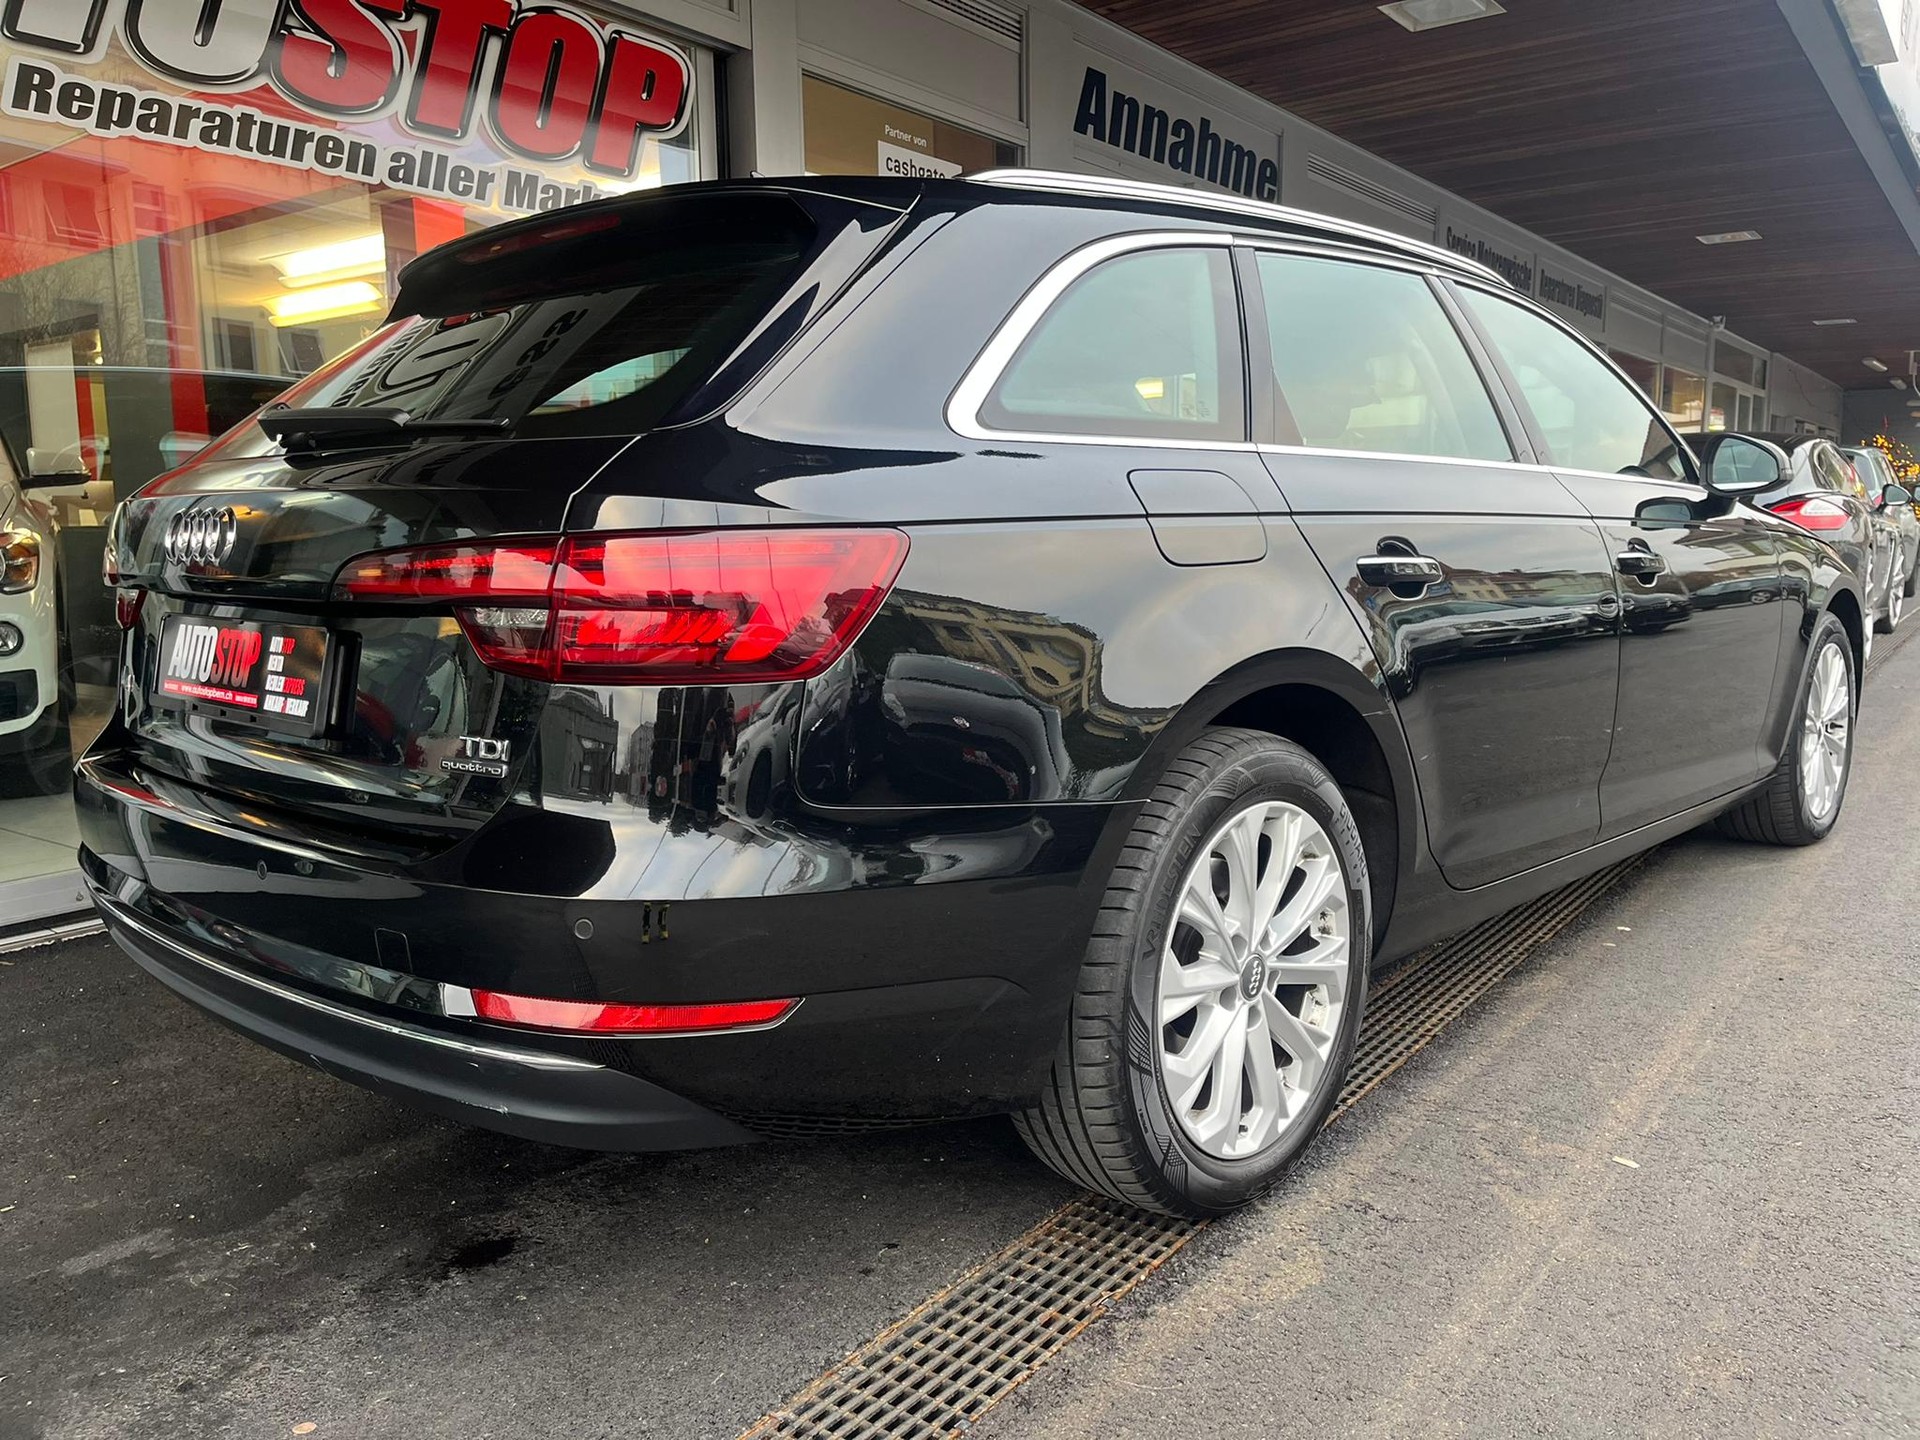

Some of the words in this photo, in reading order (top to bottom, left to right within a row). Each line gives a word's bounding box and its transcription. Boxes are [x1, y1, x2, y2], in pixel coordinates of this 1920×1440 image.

[11, 63, 377, 177] Reparaturen
[388, 150, 495, 201] aller
[504, 170, 613, 211] Mark
[884, 124, 912, 142] Partner
[913, 135, 927, 147] von
[1073, 66, 1278, 203] Annahme
[168, 624, 262, 688] AUTOSTOP
[442, 760, 502, 775] quattro
[459, 735, 511, 762] TDI
